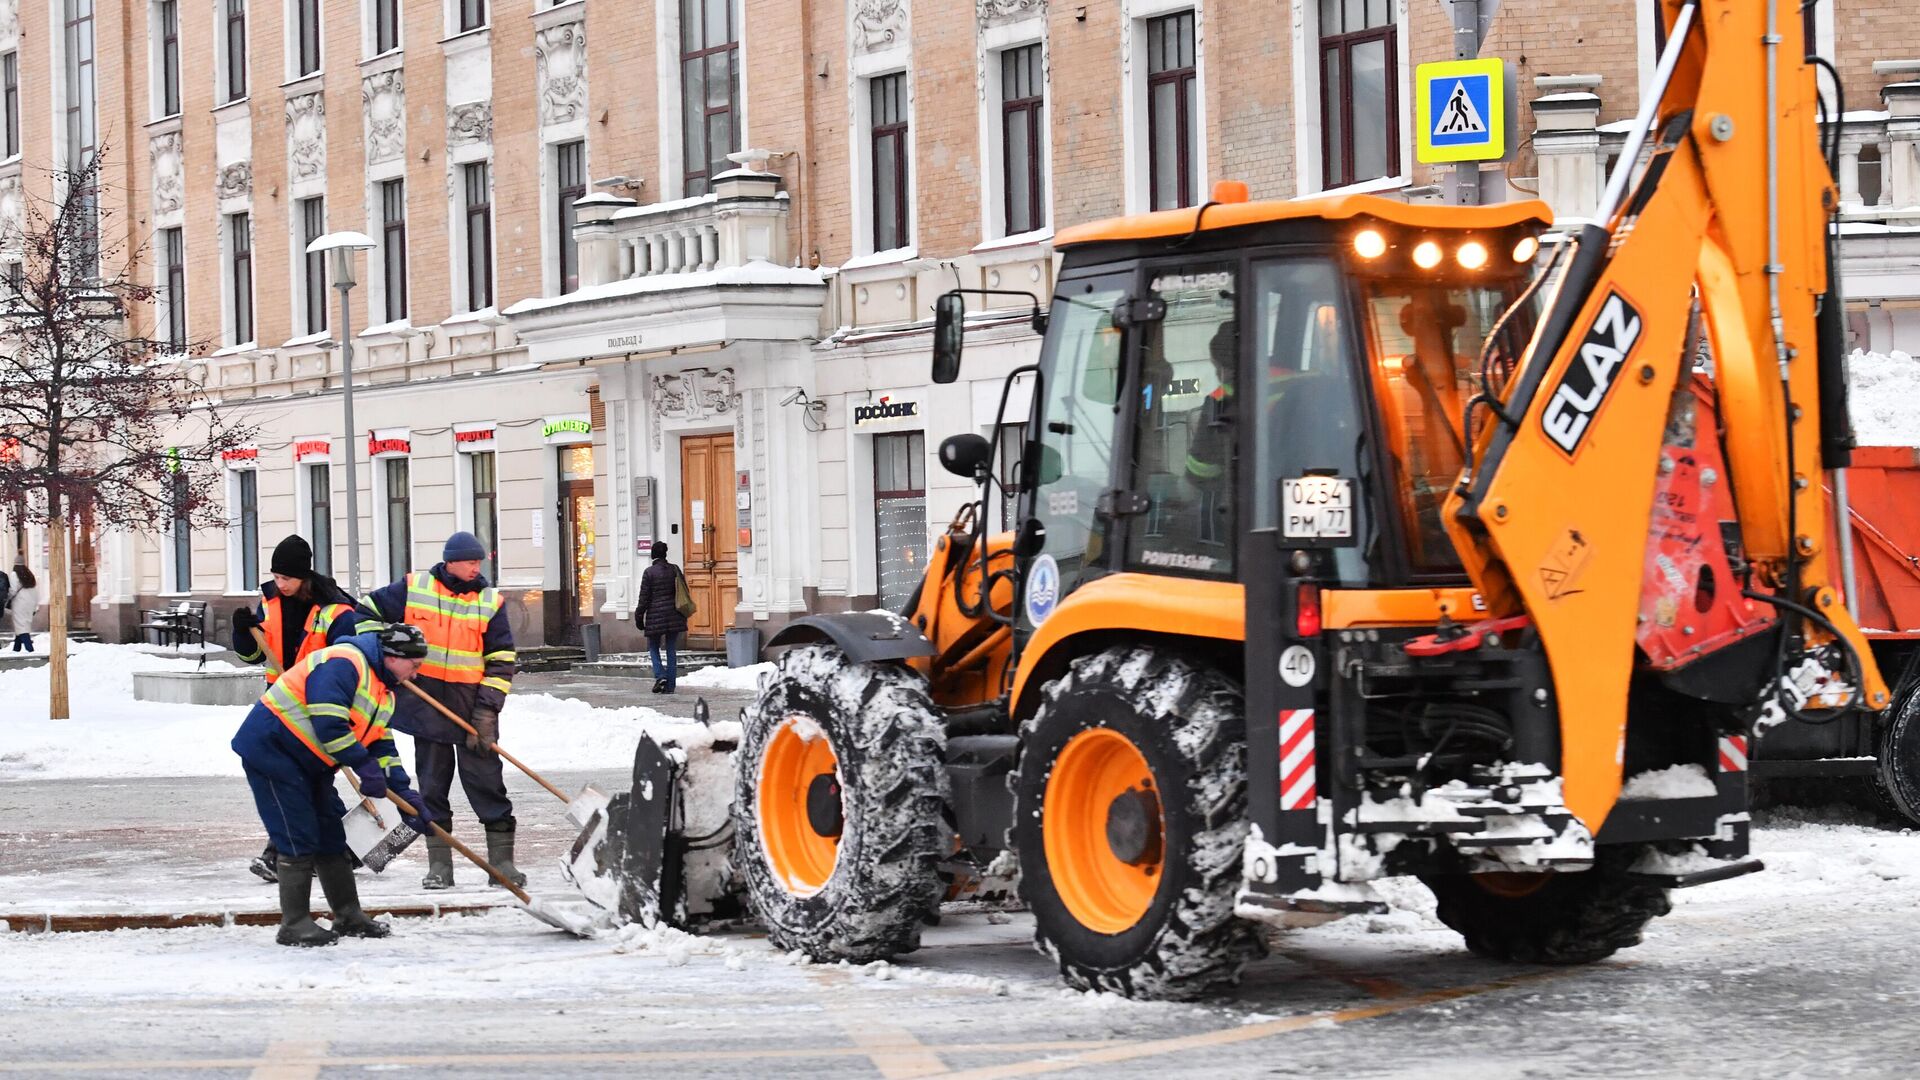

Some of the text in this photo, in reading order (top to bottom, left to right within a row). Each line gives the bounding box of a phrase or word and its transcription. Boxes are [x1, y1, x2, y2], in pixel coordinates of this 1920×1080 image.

[1543, 295, 1642, 451] ELAZ
[1292, 482, 1343, 505] 0254
[1327, 510, 1344, 527] 77
[1285, 654, 1310, 675] 40
